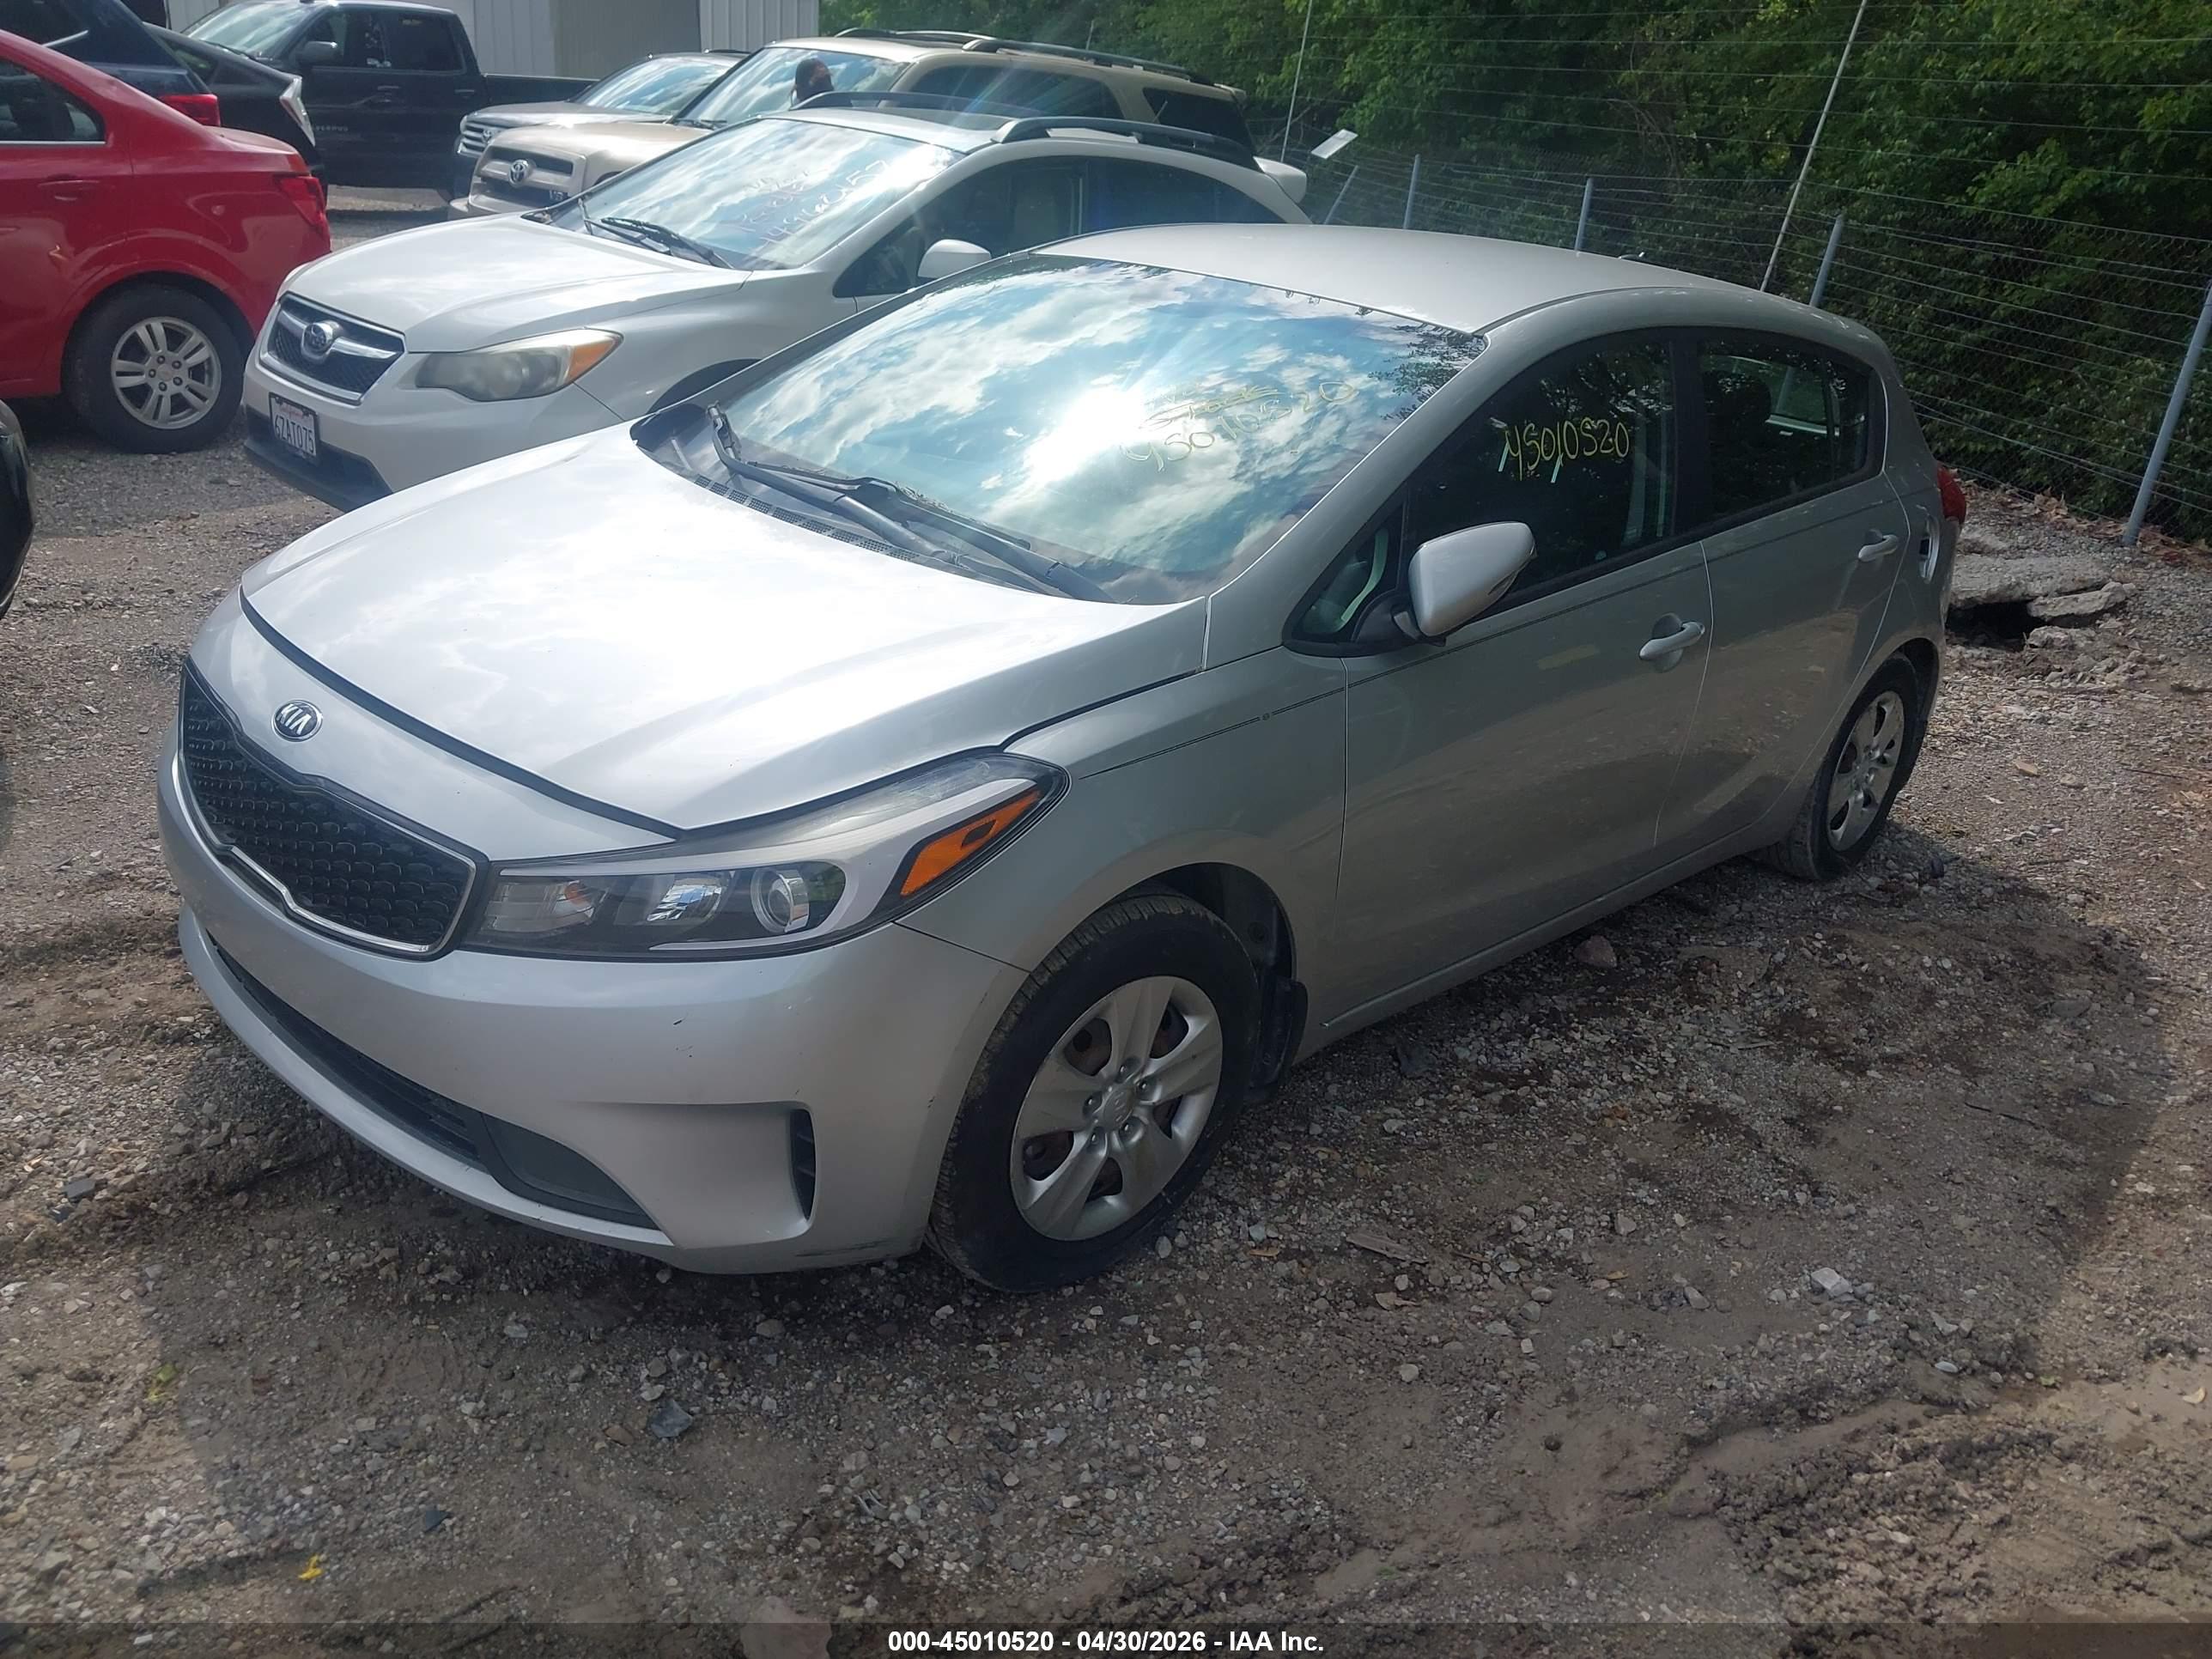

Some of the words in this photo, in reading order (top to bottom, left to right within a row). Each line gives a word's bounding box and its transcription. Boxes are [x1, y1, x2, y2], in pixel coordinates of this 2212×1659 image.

[275, 414, 315, 455] 6ZAT075
[1504, 416, 1630, 482] 45010520
[276, 703, 312, 735] KIA
